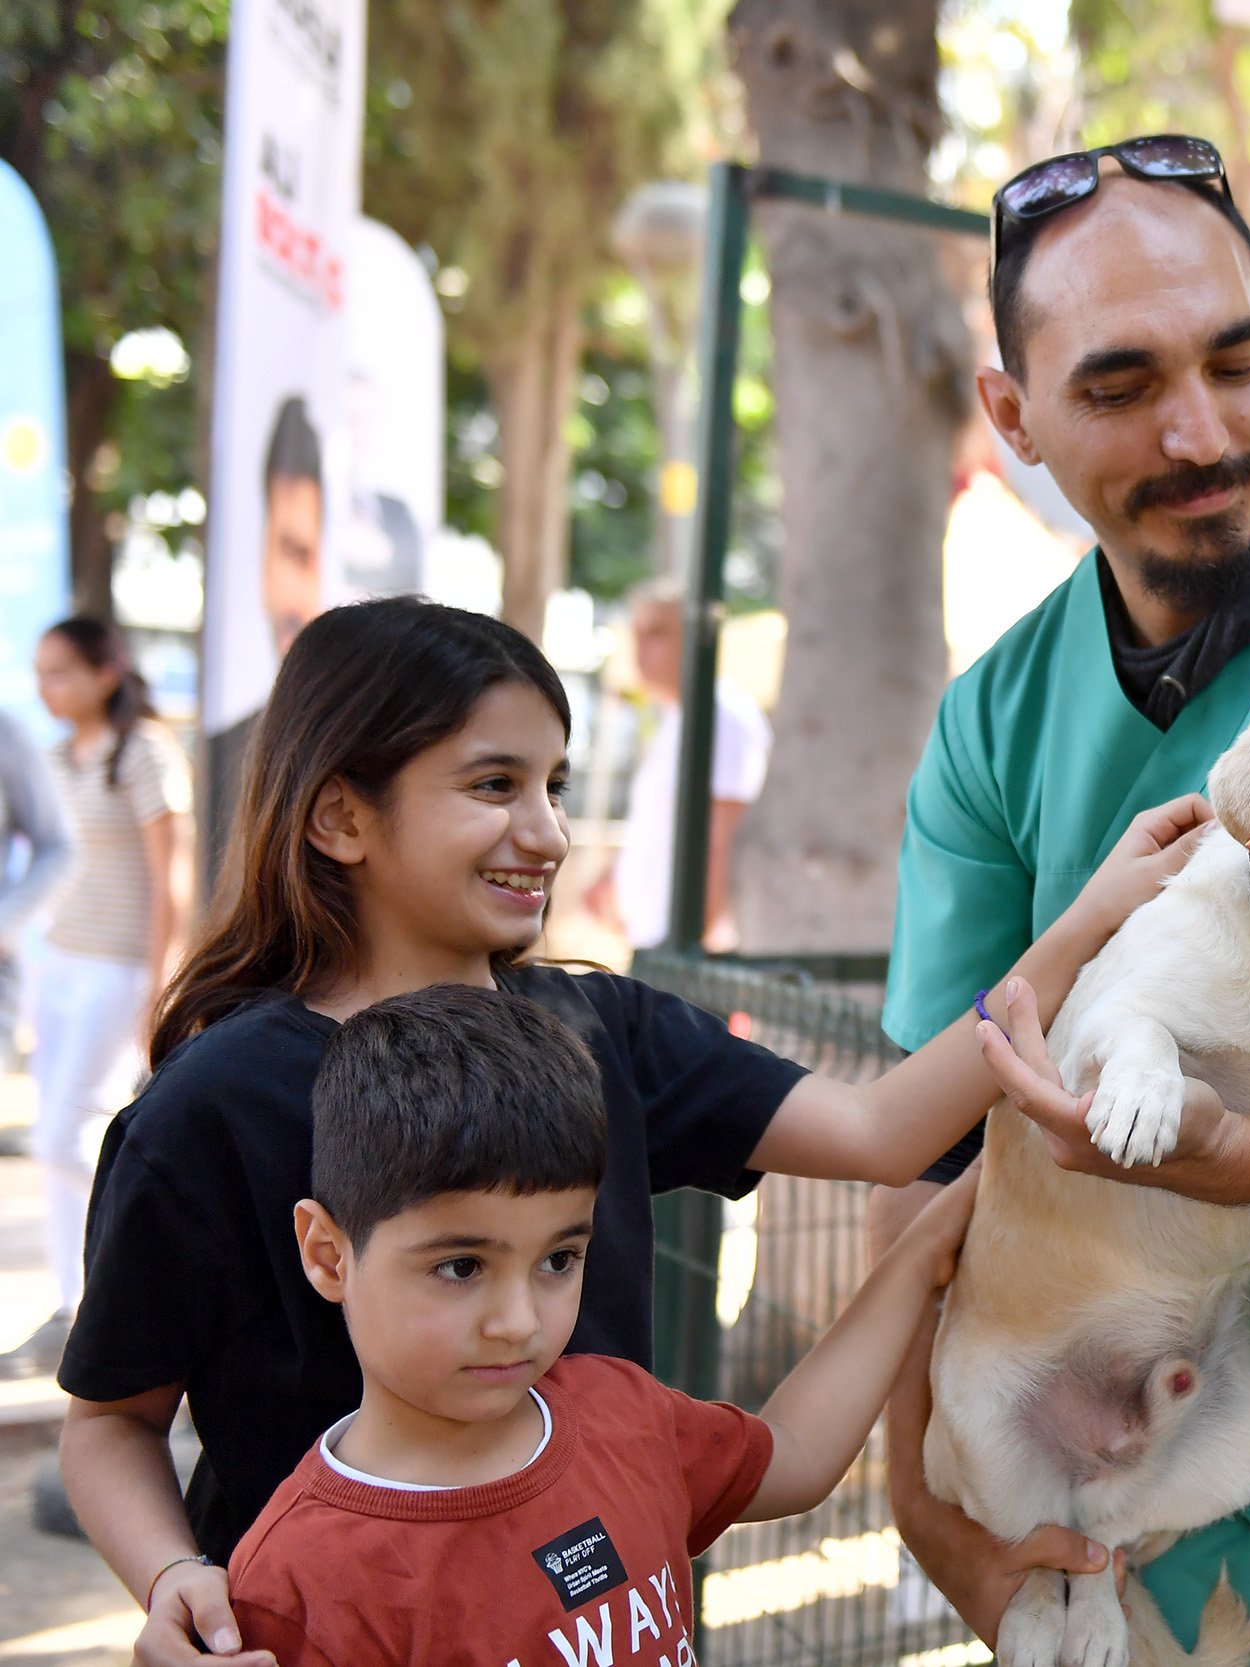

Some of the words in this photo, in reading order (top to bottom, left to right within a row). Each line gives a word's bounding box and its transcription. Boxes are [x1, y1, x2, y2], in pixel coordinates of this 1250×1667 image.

[562, 1532, 606, 1559] BASKETBALL
[565, 1554, 581, 1567] PLAY
[582, 1545, 595, 1558] OFF
